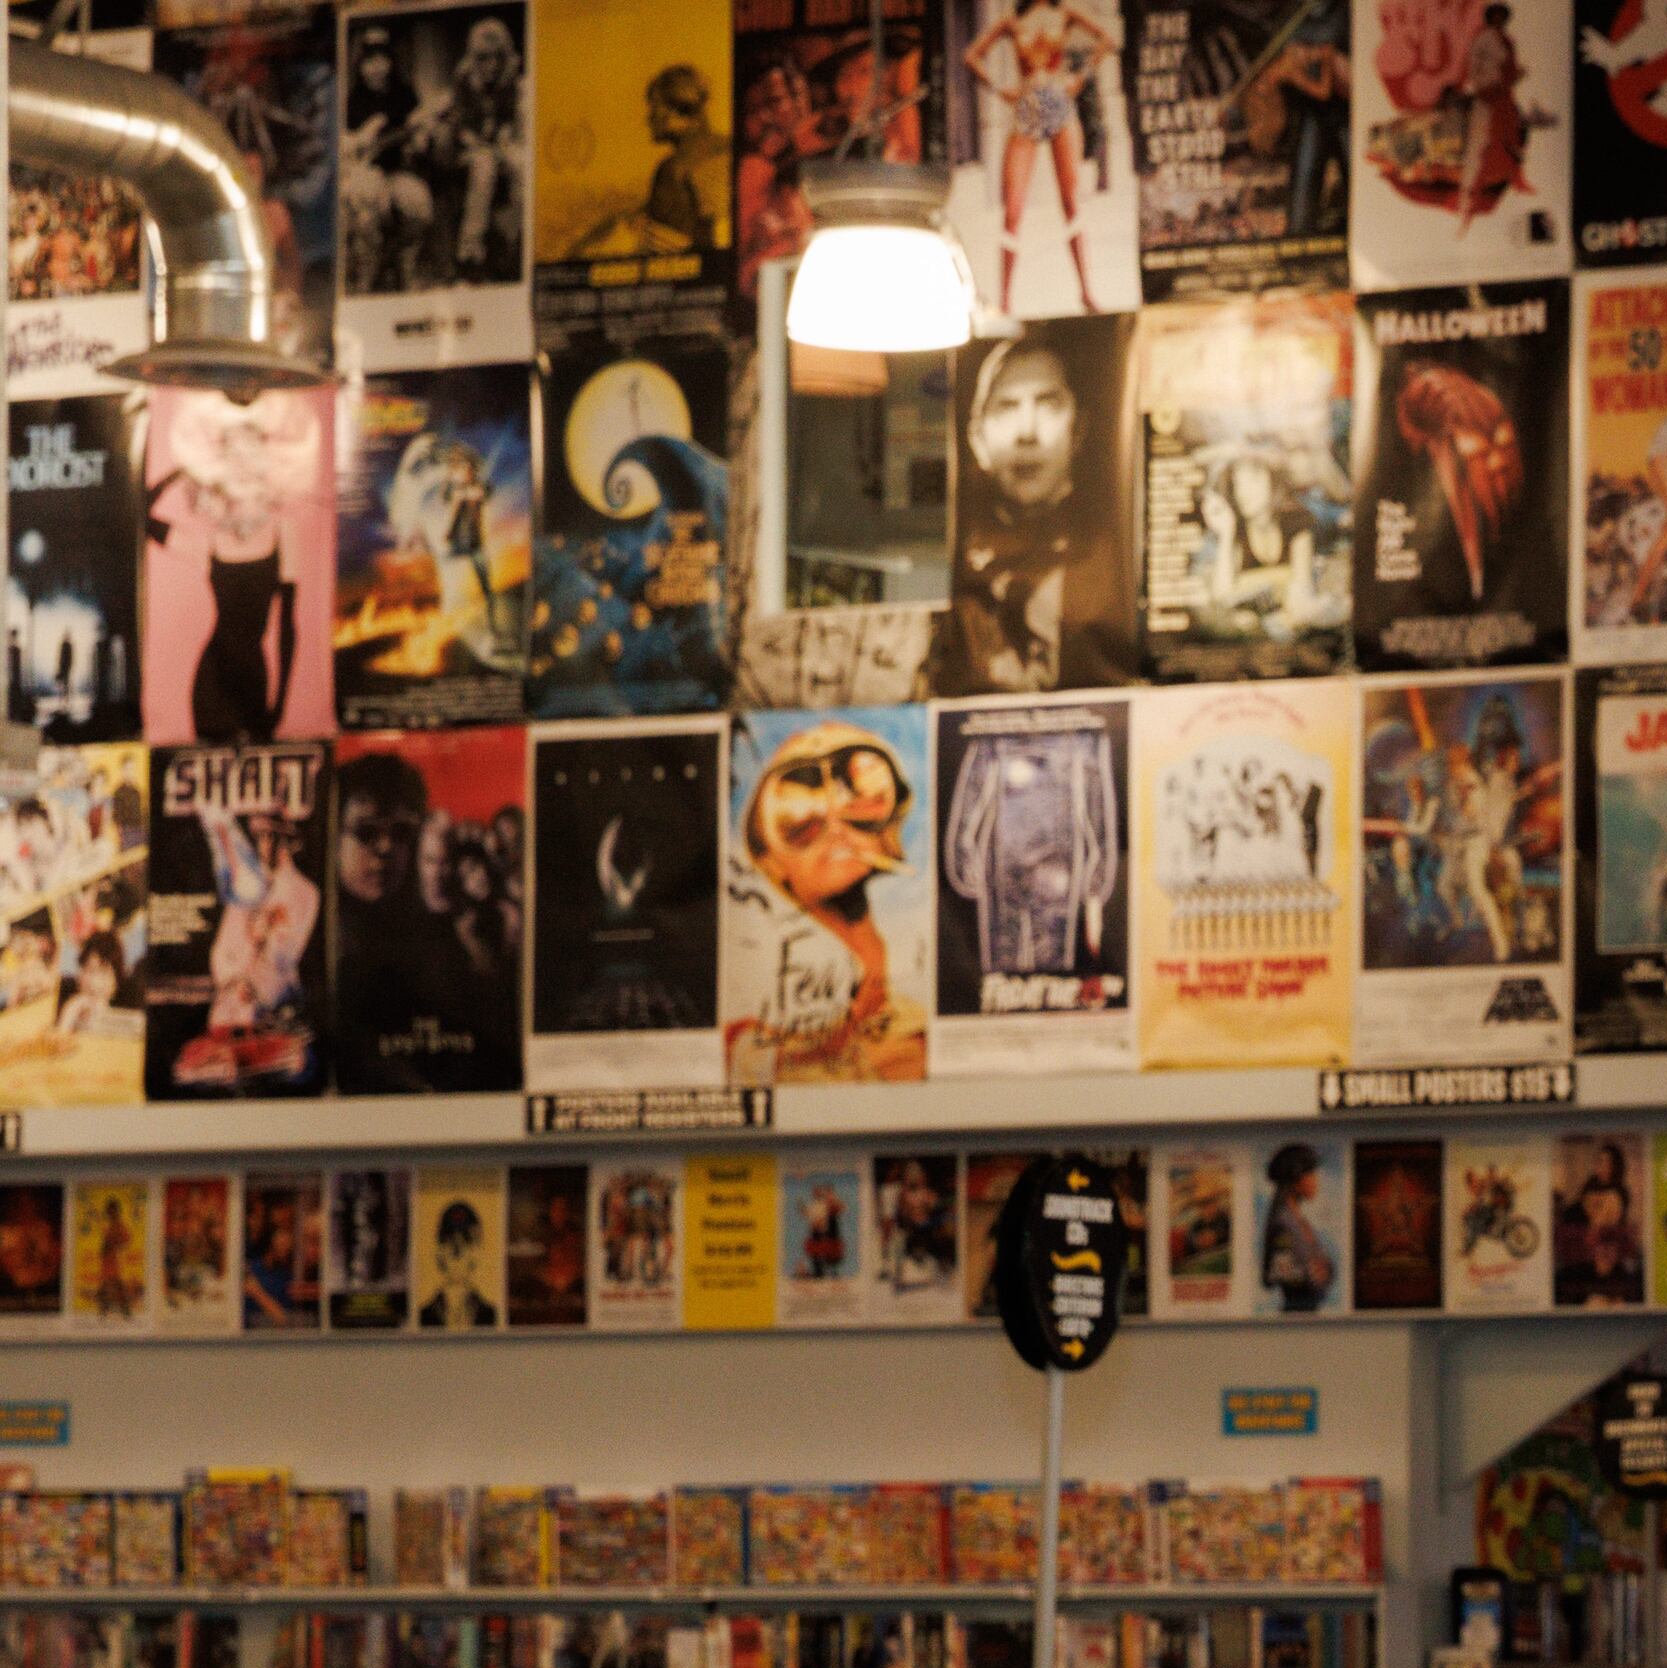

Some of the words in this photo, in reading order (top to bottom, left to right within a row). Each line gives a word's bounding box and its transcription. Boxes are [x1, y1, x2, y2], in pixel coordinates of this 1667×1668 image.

[1376, 301, 1547, 345] HALLOWEEN
[1628, 330, 1662, 369] 50
[25, 424, 74, 451] THE
[1342, 1071, 1411, 1105] SMALL
[1413, 1069, 1506, 1103] POSTERS
